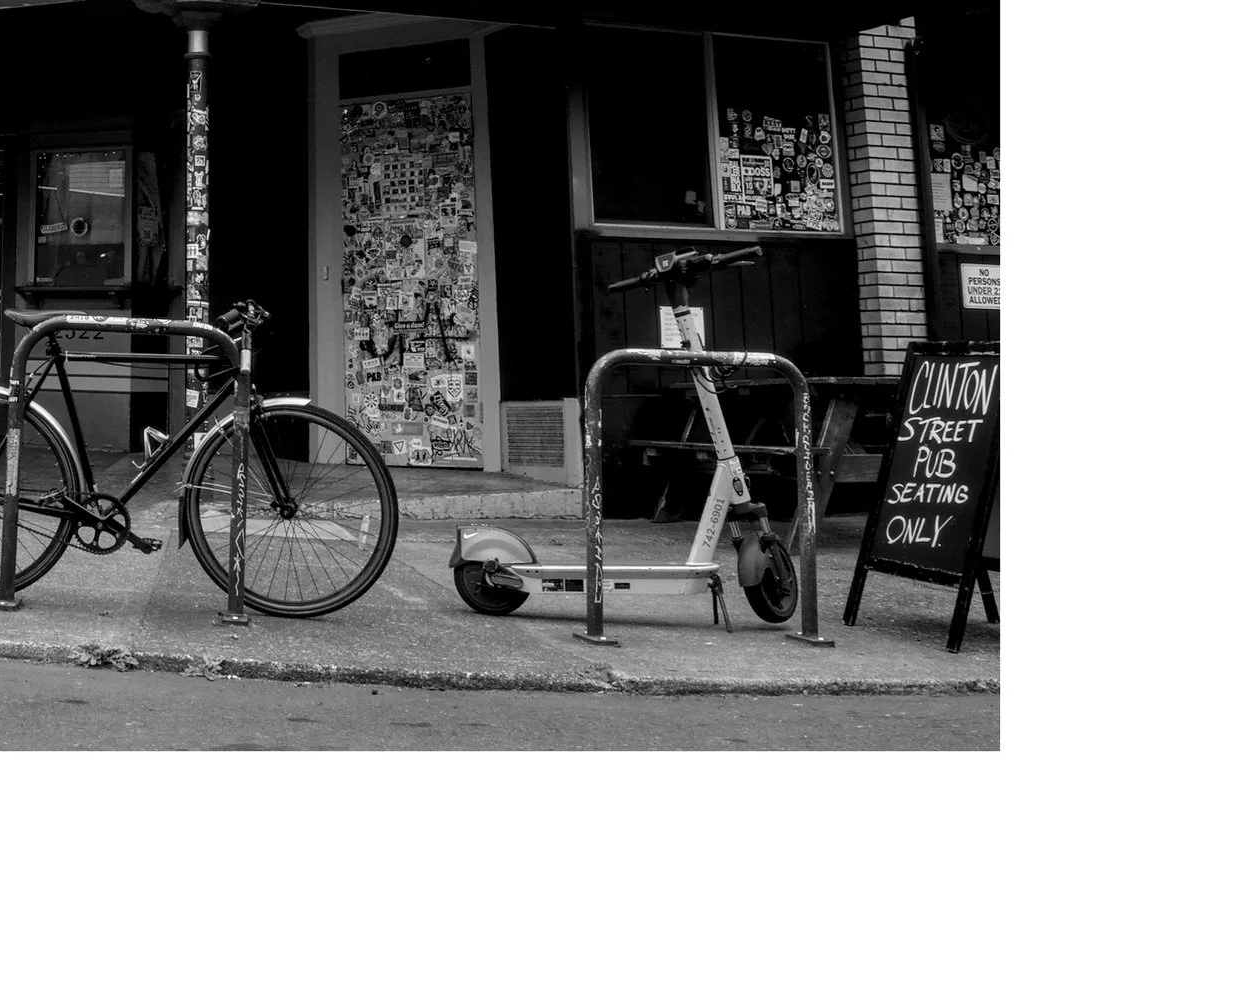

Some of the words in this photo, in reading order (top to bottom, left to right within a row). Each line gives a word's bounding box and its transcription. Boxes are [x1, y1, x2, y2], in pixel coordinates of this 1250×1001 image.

[968, 286, 992, 295] UNDER
[909, 360, 998, 415] CLINTON
[897, 417, 983, 444] STREET
[913, 446, 956, 478] PUB
[887, 483, 969, 504] SEATING
[703, 499, 725, 548] 742-6901
